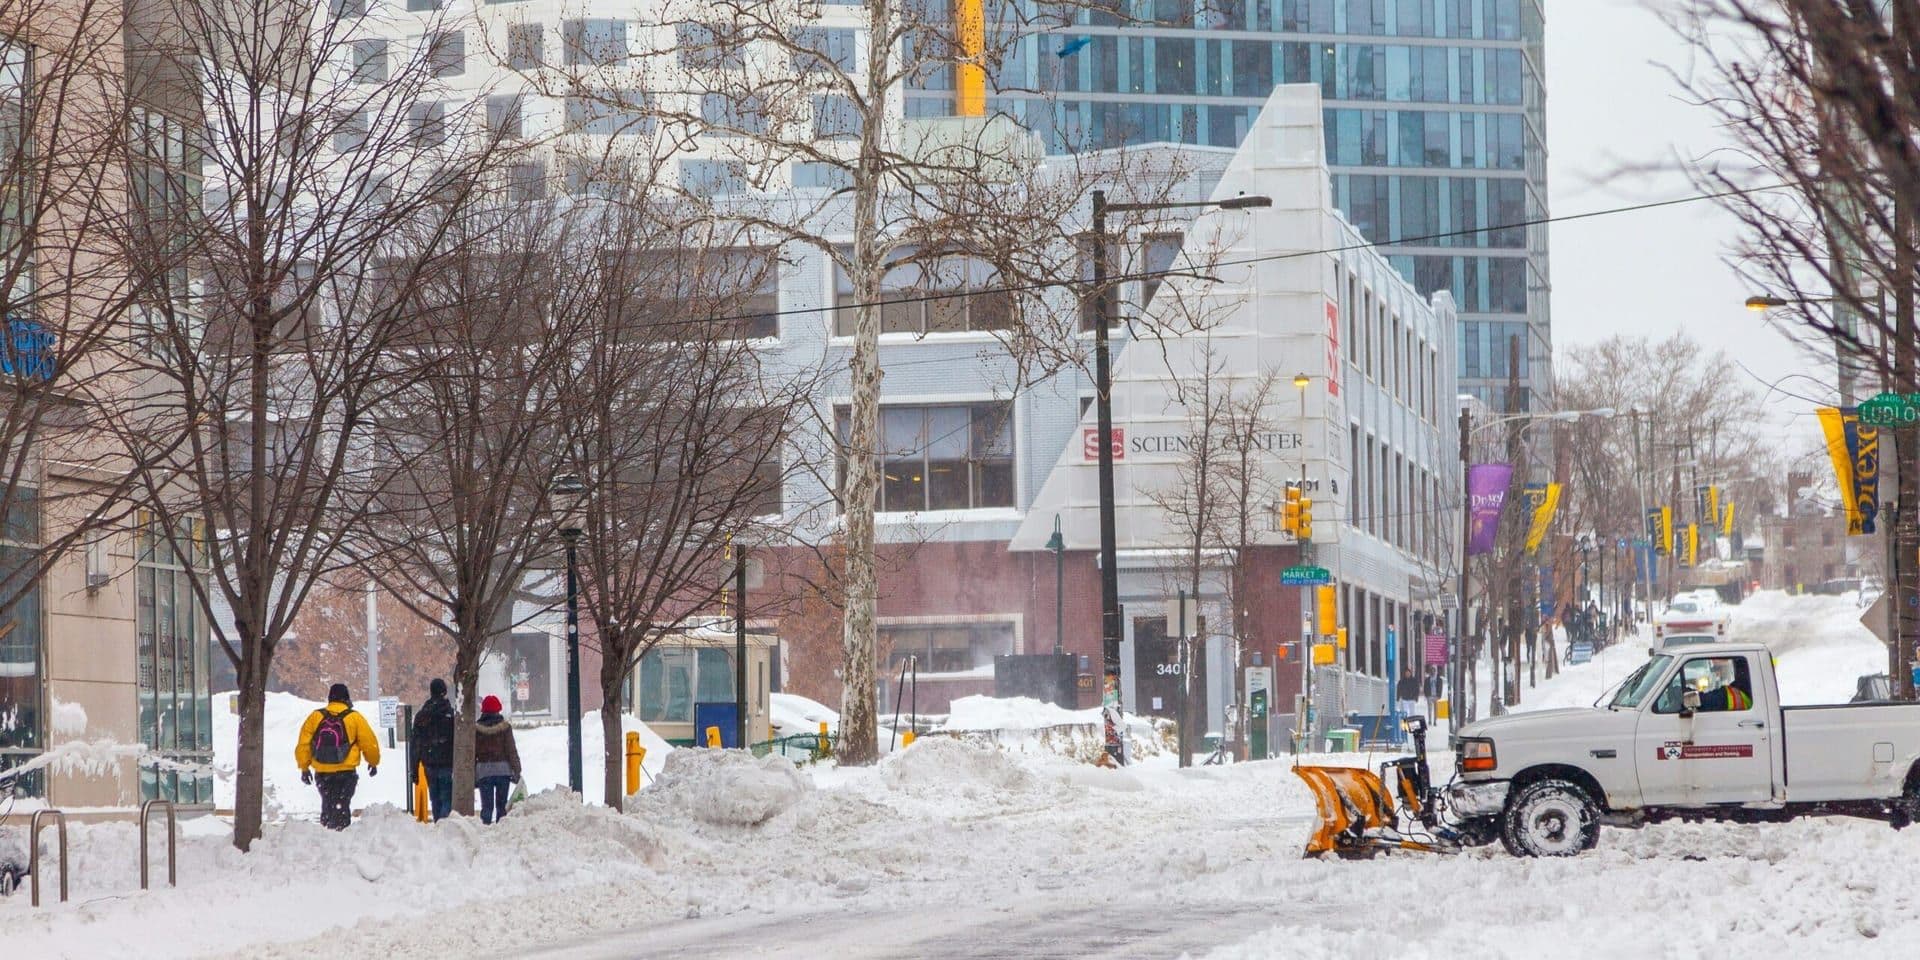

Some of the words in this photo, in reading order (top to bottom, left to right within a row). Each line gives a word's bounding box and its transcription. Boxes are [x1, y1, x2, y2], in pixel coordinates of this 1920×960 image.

[1862, 405, 1920, 423] LUDLO
[1132, 434, 1213, 453] SCIENCE
[1222, 433, 1303, 452] CENTER
